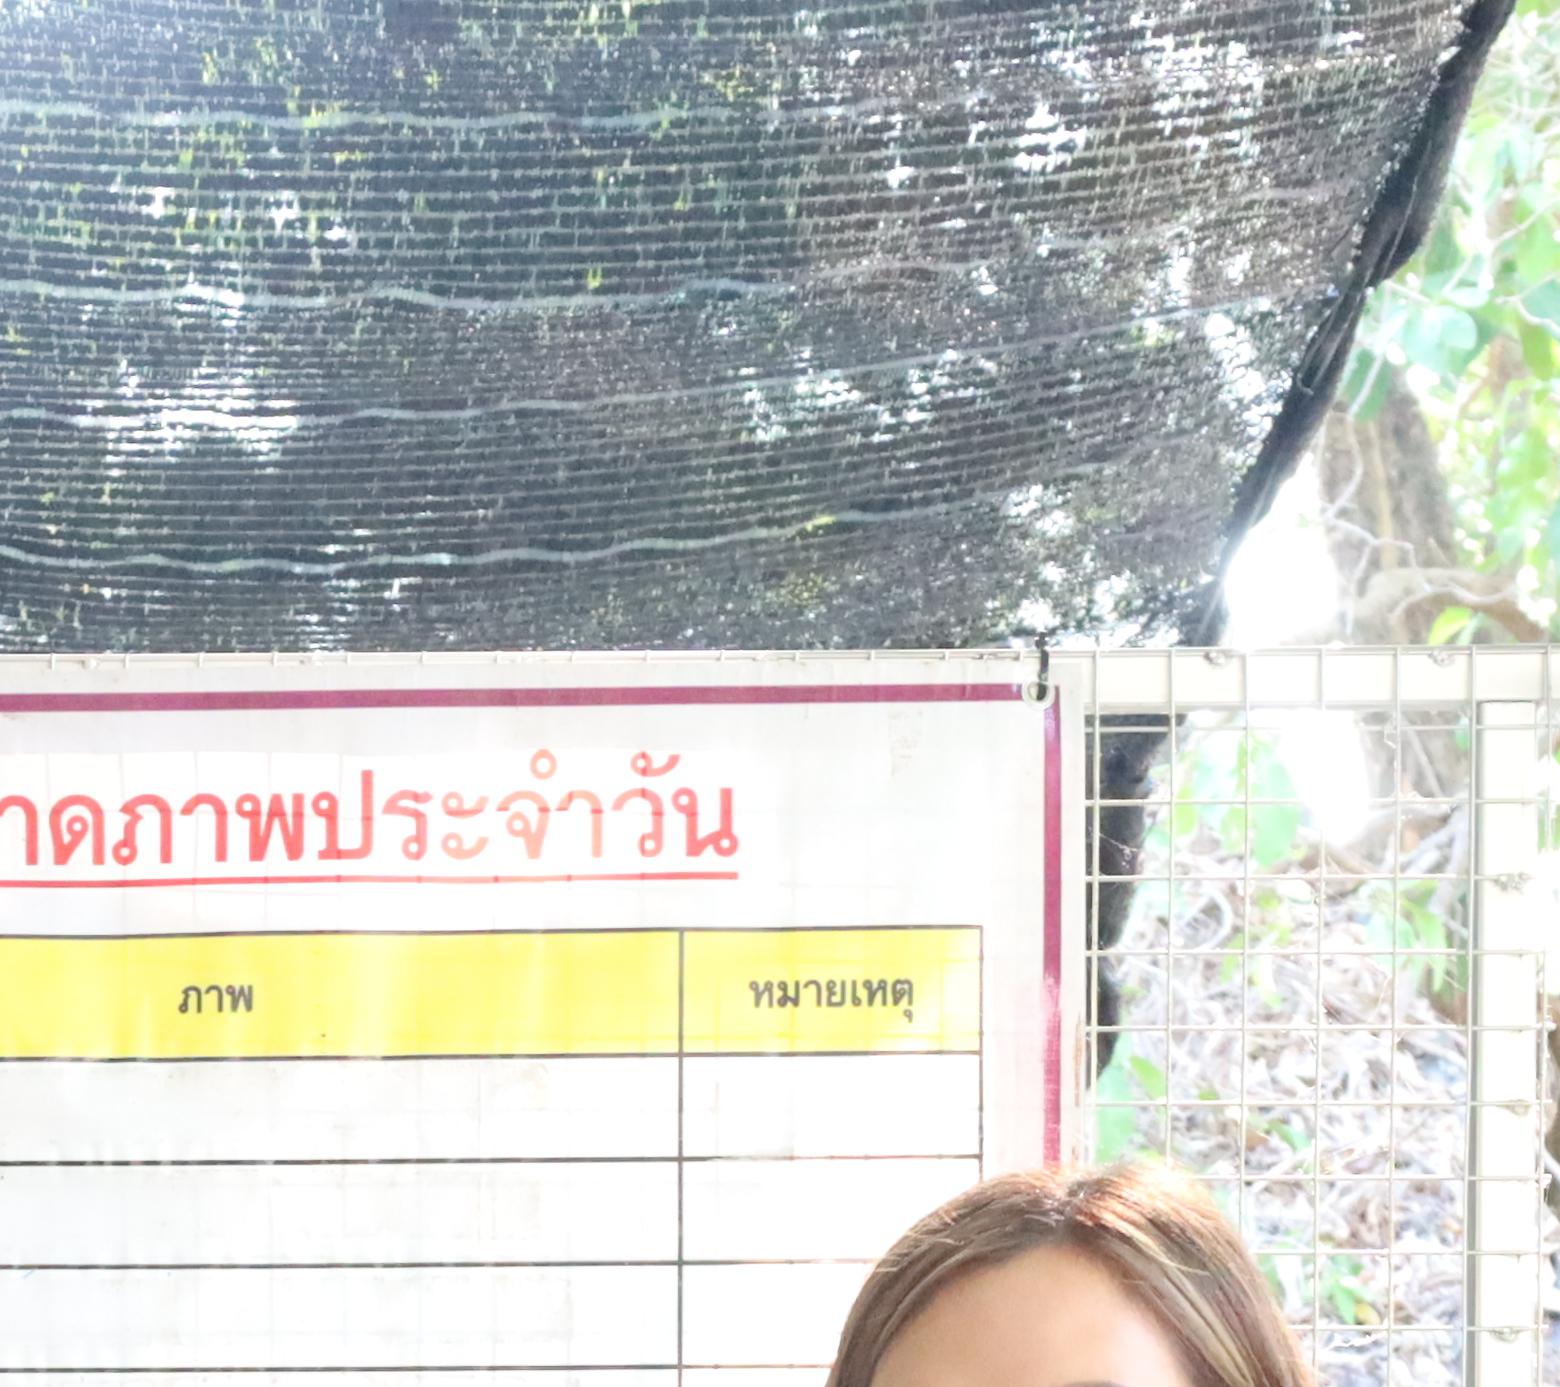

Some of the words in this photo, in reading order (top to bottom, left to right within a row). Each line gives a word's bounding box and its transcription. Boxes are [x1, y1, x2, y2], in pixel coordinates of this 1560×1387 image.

[178, 984, 253, 1014] ภาพ
[749, 978, 913, 1021] หมายเหตุ
